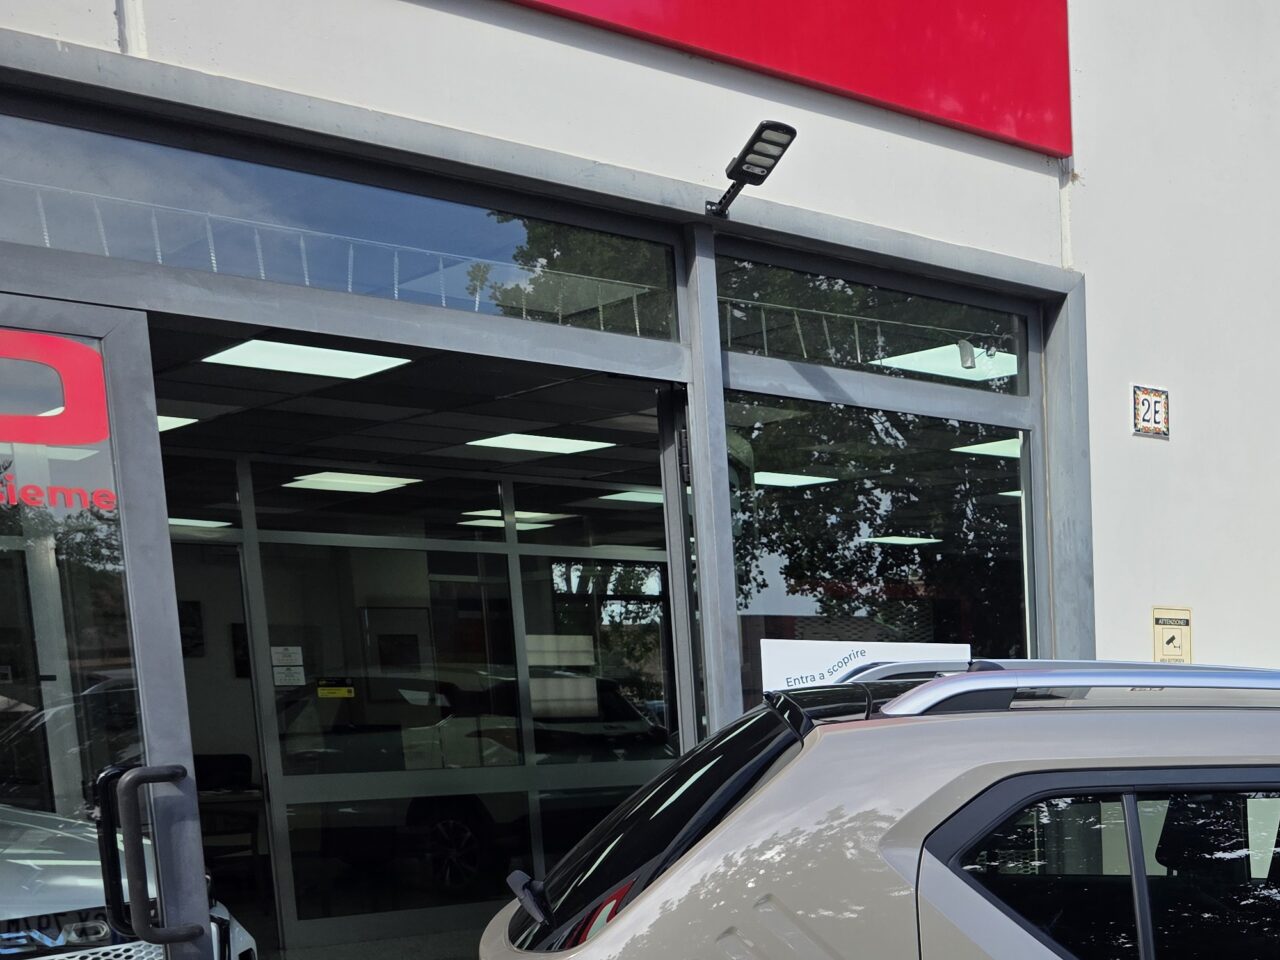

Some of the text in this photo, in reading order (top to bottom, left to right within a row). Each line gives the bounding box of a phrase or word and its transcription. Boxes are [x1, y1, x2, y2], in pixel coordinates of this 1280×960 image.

[1141, 398, 1161, 425] 2E
[0, 473, 117, 510] ieme
[785, 672, 816, 687] Entra
[827, 648, 867, 676] scoprire
[0, 920, 111, 955] EVO
